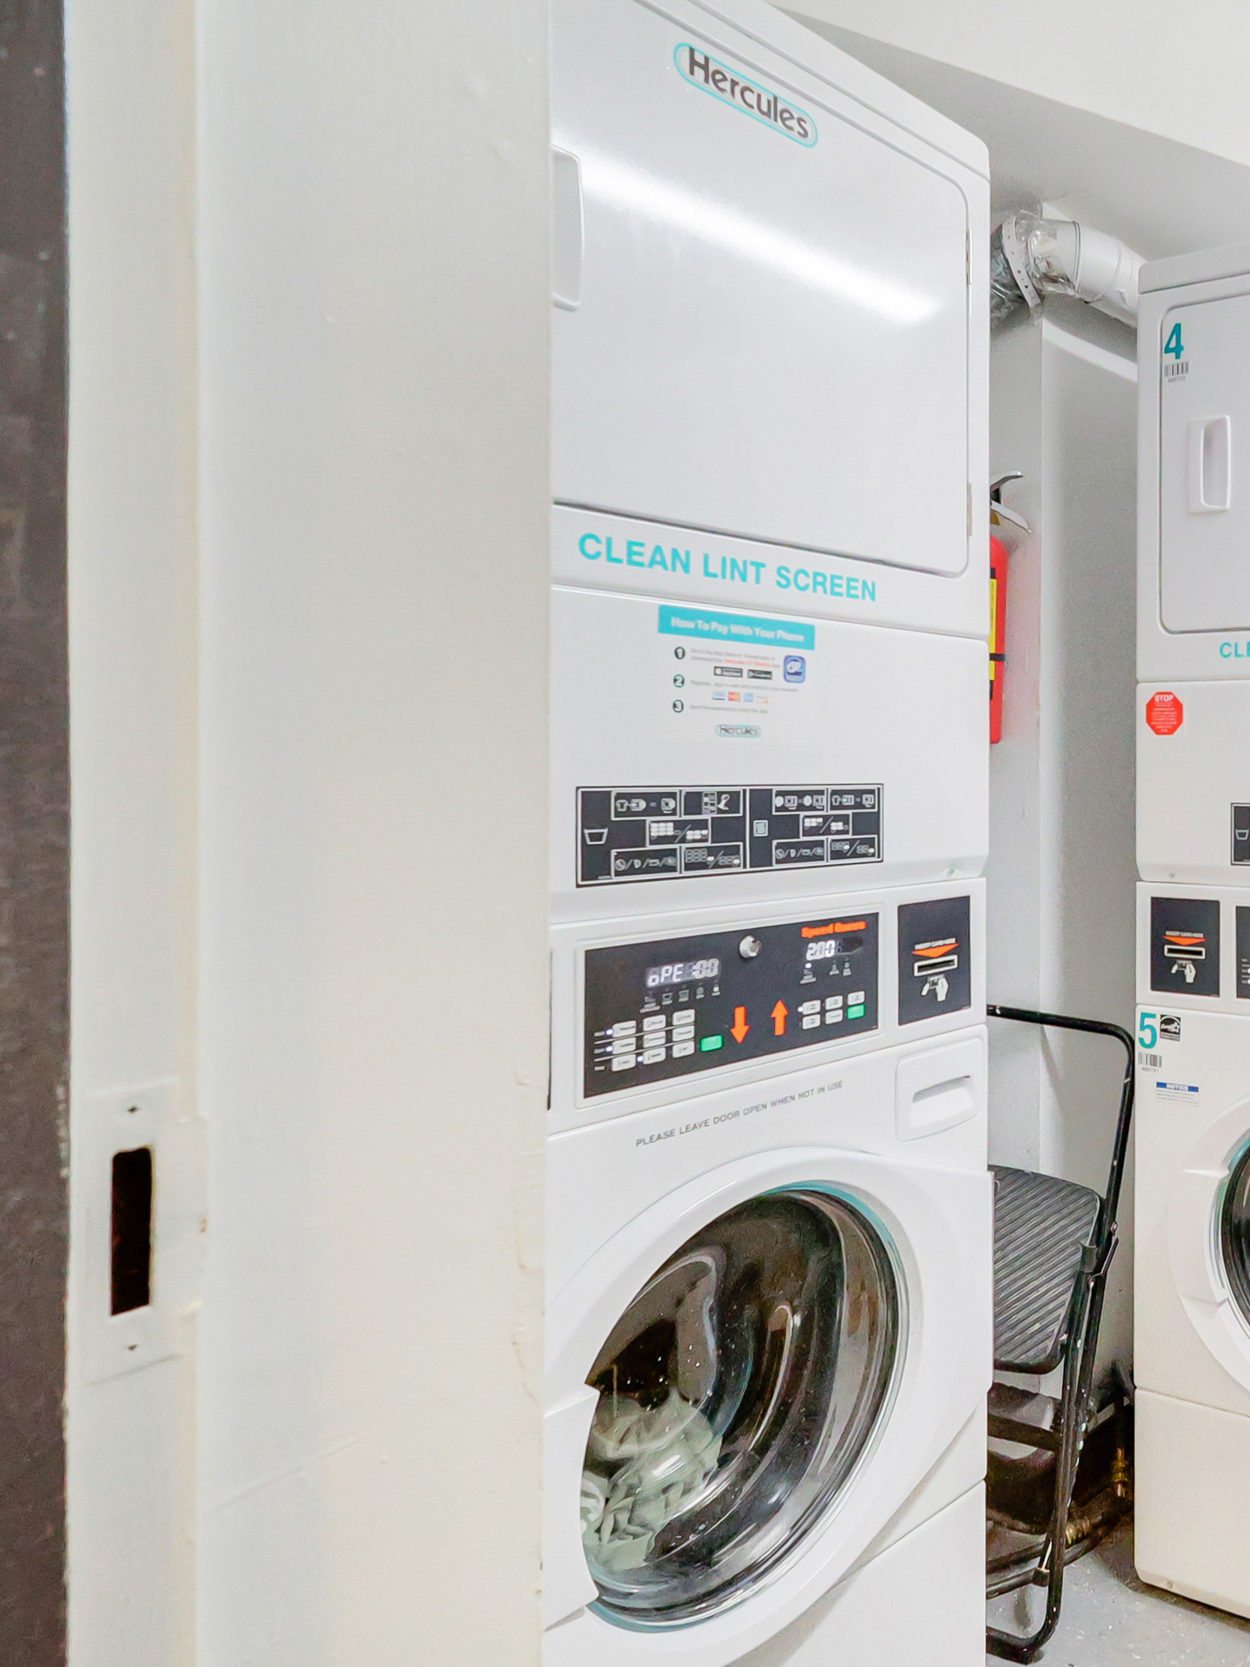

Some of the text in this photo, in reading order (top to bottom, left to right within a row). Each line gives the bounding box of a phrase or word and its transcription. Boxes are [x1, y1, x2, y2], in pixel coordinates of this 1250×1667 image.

[689, 46, 809, 139] Hercules
[1163, 323, 1184, 360] 4
[578, 533, 876, 602] CLEAN LINT SCREEN
[671, 617, 805, 642] How To Pay With Your Phone
[1154, 694, 1174, 702] STOP
[1138, 1012, 1157, 1049] 5
[635, 1080, 843, 1147] PLEASE LEAVE DOOR OPEN WHEN NOT IN USE
